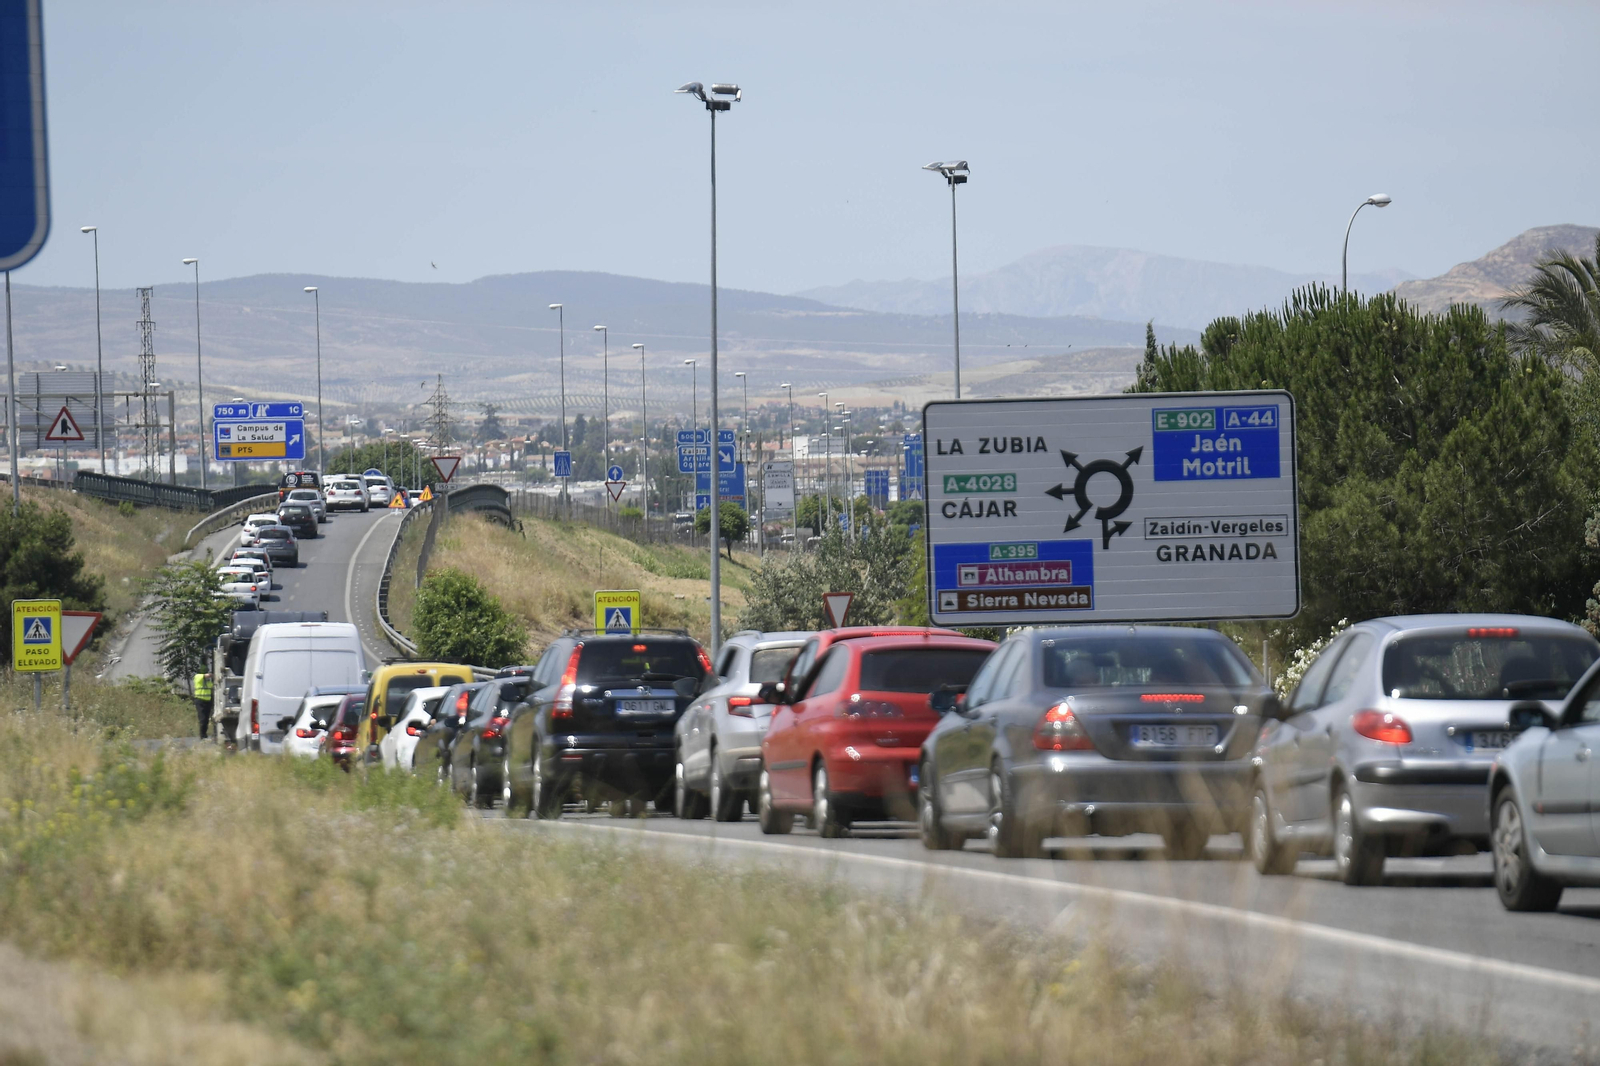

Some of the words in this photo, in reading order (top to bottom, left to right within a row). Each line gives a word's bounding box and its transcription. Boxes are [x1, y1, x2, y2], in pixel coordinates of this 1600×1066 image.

[217, 407, 234, 415] 750
[289, 406, 300, 414] 1C
[1227, 410, 1274, 427] A-44
[1157, 412, 1213, 429] E-902
[237, 425, 269, 434] Campus
[937, 438, 964, 455] LA
[978, 436, 1048, 454] ZUBIA
[1191, 433, 1242, 453] Jaén
[1182, 457, 1251, 477] Motril
[946, 475, 1015, 492] A-4028
[941, 497, 1018, 519] CÁJAR
[1149, 519, 1284, 536] Zaidín-Vergeles
[992, 545, 1036, 558] A-395
[1156, 541, 1278, 562] GRANADA
[984, 566, 1068, 583] Alhambra
[967, 594, 1019, 608] Sierra
[1024, 591, 1089, 606] Nevada
[18, 658, 58, 667] ELEVADO
[624, 701, 649, 711] 0611
